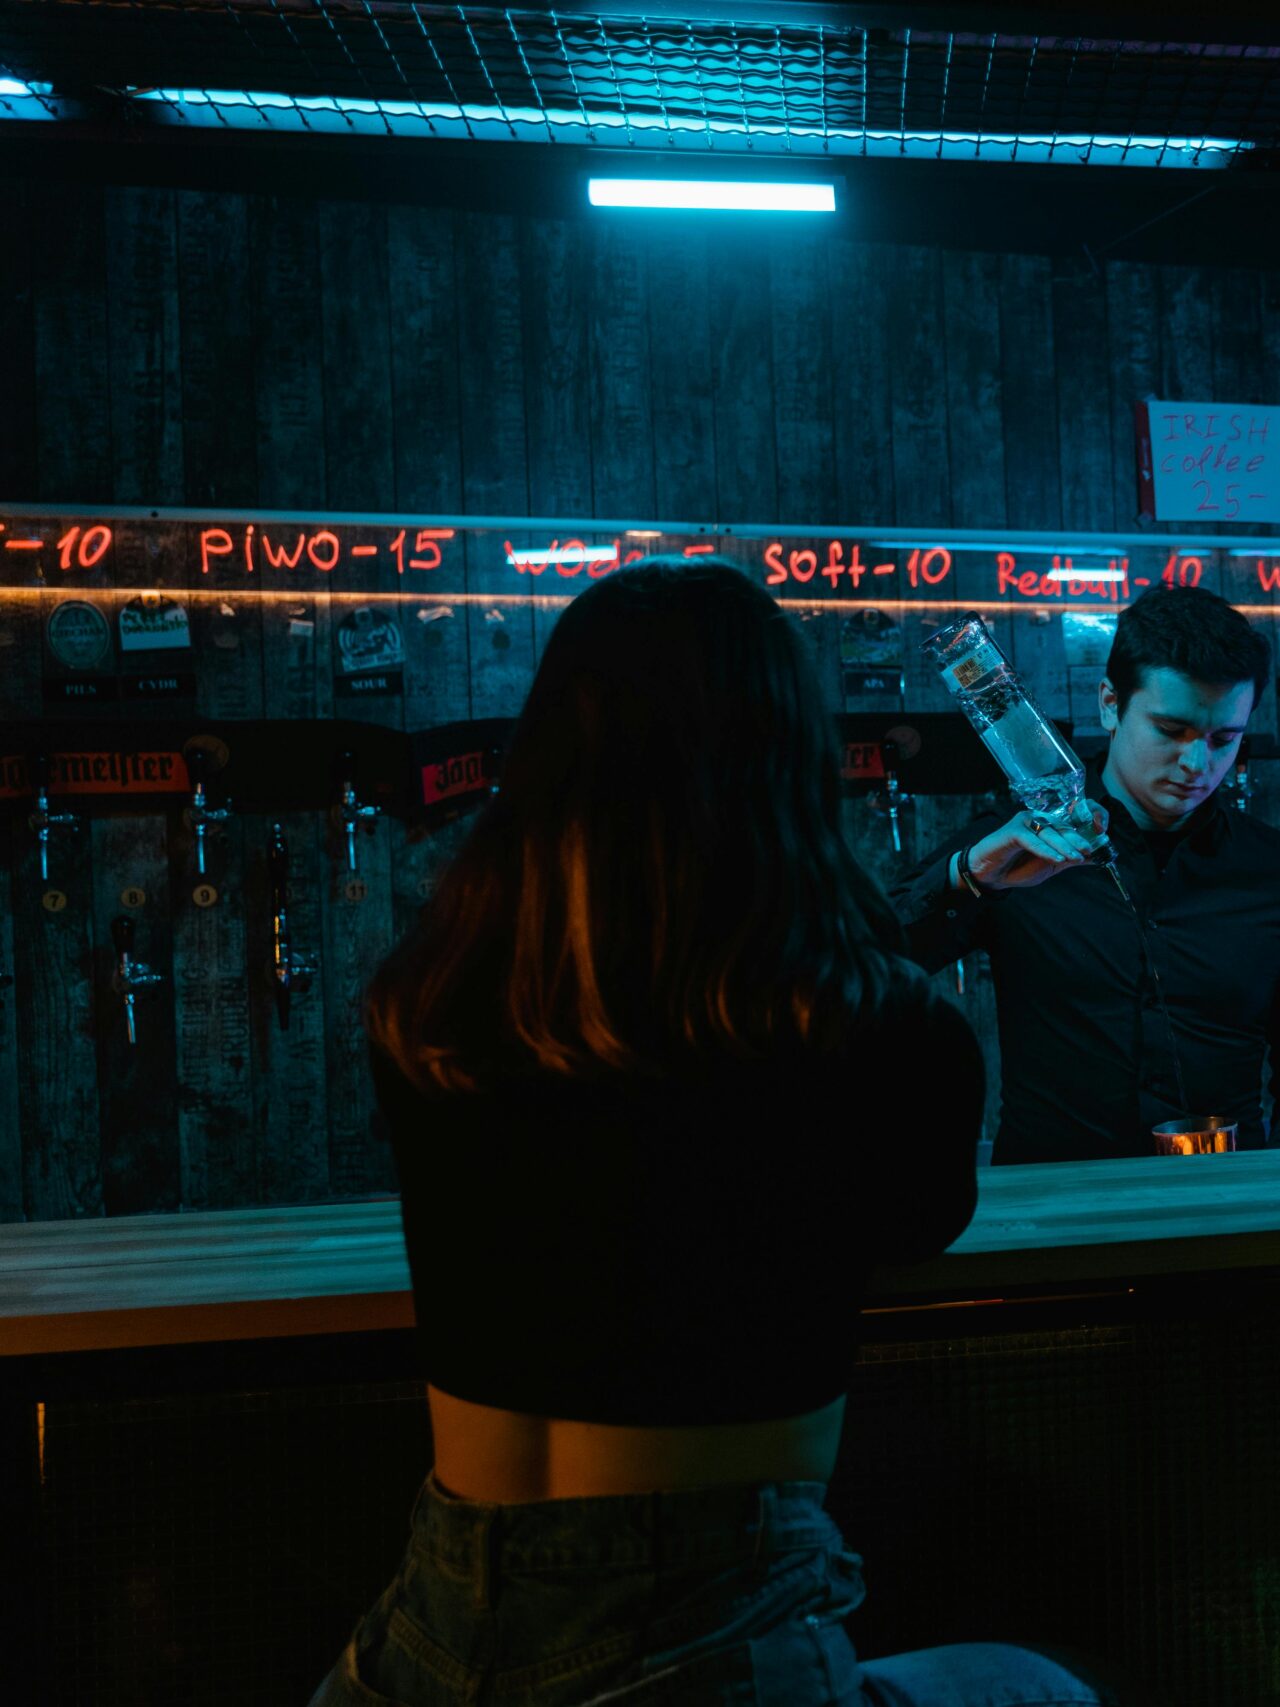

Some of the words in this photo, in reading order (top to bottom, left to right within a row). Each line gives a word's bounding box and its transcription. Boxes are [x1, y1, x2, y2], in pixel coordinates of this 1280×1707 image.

[1161, 414, 1271, 443] IRISH
[64, 683, 97, 696] PILS
[138, 678, 178, 692] CYDR
[350, 677, 388, 691] SOUR
[128, 891, 139, 905] 8
[200, 889, 211, 903] 9
[350, 886, 365, 898] 11
[50, 894, 60, 908] 7
